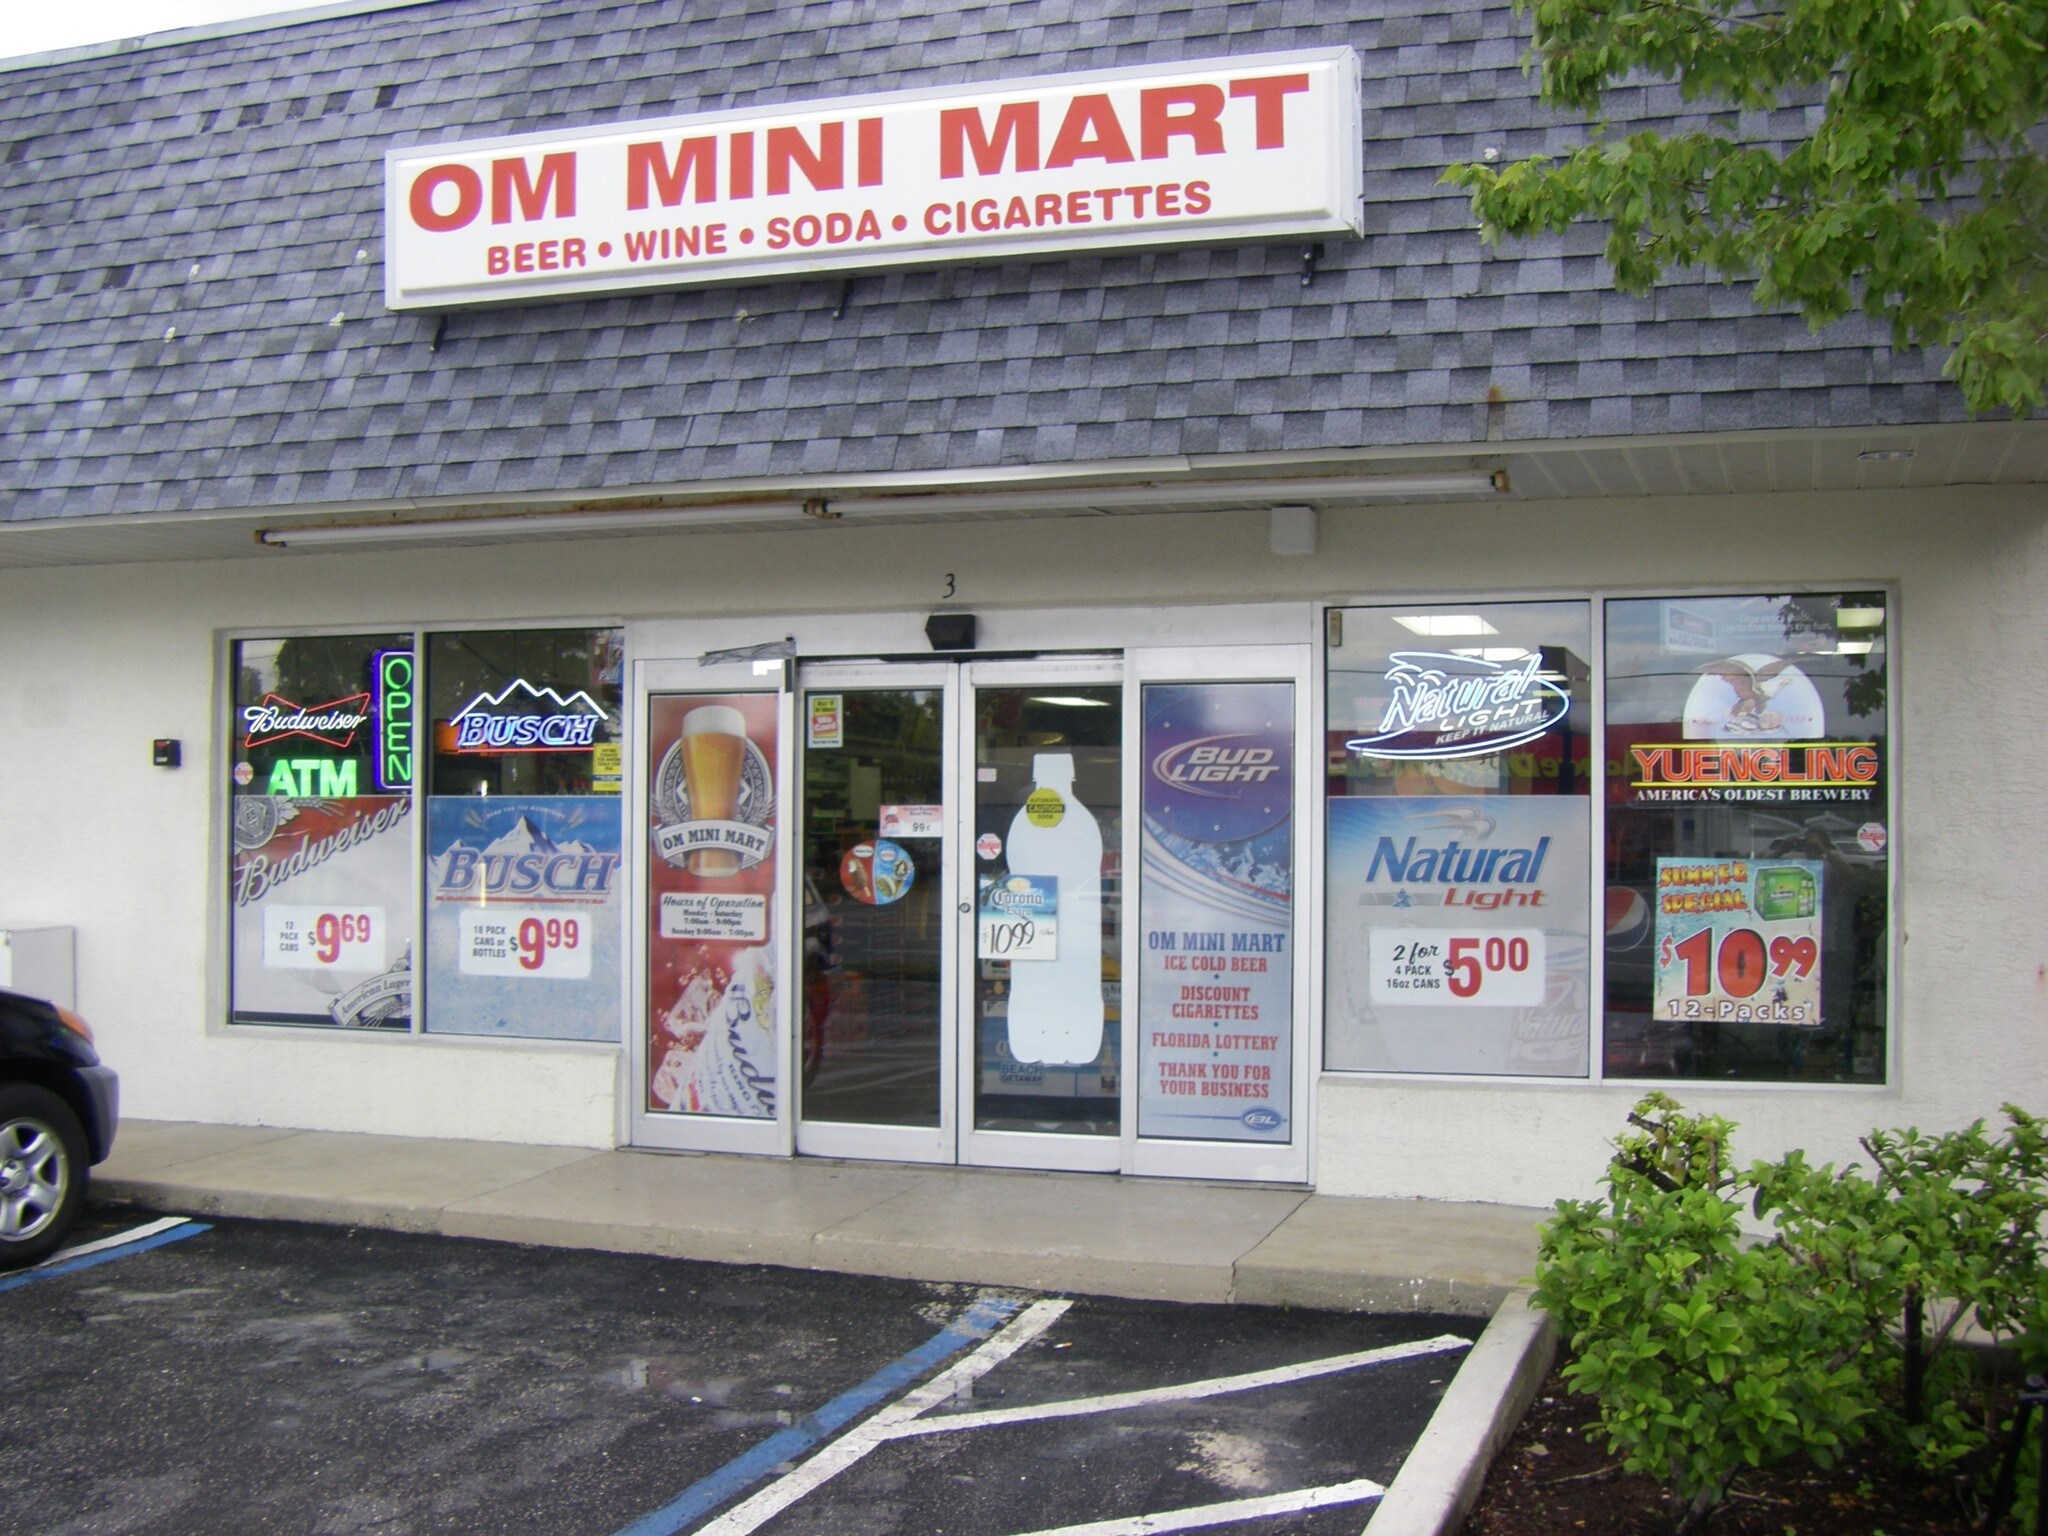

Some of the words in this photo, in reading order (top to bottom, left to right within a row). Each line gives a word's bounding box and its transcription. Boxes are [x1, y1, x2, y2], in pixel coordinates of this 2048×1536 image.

[409, 151, 578, 233] OM
[627, 117, 884, 211] MINI
[940, 74, 1309, 179] MART
[487, 229, 587, 276] BEER
[625, 222, 727, 263] WINE
[766, 209, 880, 250] SODA
[923, 180, 1211, 237] CIGARETTES
[943, 574, 955, 598] 3
[1379, 653, 1543, 733] Natural
[244, 705, 367, 733] Budweiser
[384, 658, 411, 781] OPEN
[1440, 699, 1542, 732] LIGHT
[457, 712, 598, 747] BUSCH
[1435, 728, 1472, 745] KEEP
[1489, 711, 1550, 732] NATURAL
[1188, 747, 1273, 765] BUD
[1632, 747, 1878, 782] YUENGLING
[267, 759, 358, 797] ATM
[1169, 766, 1280, 782] LIGHT
[1637, 788, 1720, 801] AMERICA'S
[1724, 788, 1783, 801] OLDEST
[1790, 788, 1872, 801] BREWERY
[663, 836, 684, 851] OM
[688, 829, 720, 843] MINI
[725, 830, 765, 852] MART
[235, 798, 408, 907] Budweiser
[1365, 836, 1551, 883] Natural
[437, 849, 618, 894] BUSCH
[663, 896, 694, 907] Hours
[696, 896, 709, 910] of
[710, 897, 764, 909] Operation
[990, 888, 1043, 907] Corona
[1443, 888, 1548, 910] Light
[285, 921, 294, 930] 12
[474, 926, 483, 935] 18
[486, 925, 507, 936] PACK
[280, 932, 299, 942] PACK
[474, 937, 496, 947] CANS
[1149, 931, 1176, 950] OM
[1183, 932, 1225, 951] MINI
[1232, 933, 1285, 952] MART
[280, 943, 299, 952] CANS
[473, 947, 507, 958] BOTTLES
[1393, 945, 1405, 961] 2
[1409, 942, 1440, 965] for
[1165, 956, 1187, 970] ICE
[1192, 956, 1226, 971] COLD
[1231, 957, 1267, 972] BEER
[1395, 966, 1401, 975] 4
[1405, 966, 1432, 976] PACK
[1181, 986, 1251, 1001] DISCOUNT
[1386, 978, 1410, 989] 16oz
[1413, 978, 1440, 989] CANS
[1172, 1004, 1259, 1020] CIGARETTES
[1667, 999, 1805, 1020] 12-Packs
[1152, 1032, 1211, 1048] FLORIDA
[1215, 1034, 1279, 1051] LOTTERY
[1158, 1062, 1207, 1078] THANK
[1212, 1064, 1239, 1079] YOU
[1244, 1065, 1271, 1080] FOR
[1159, 1080, 1196, 1095] YOUR
[1201, 1082, 1269, 1098] BUSINESS
